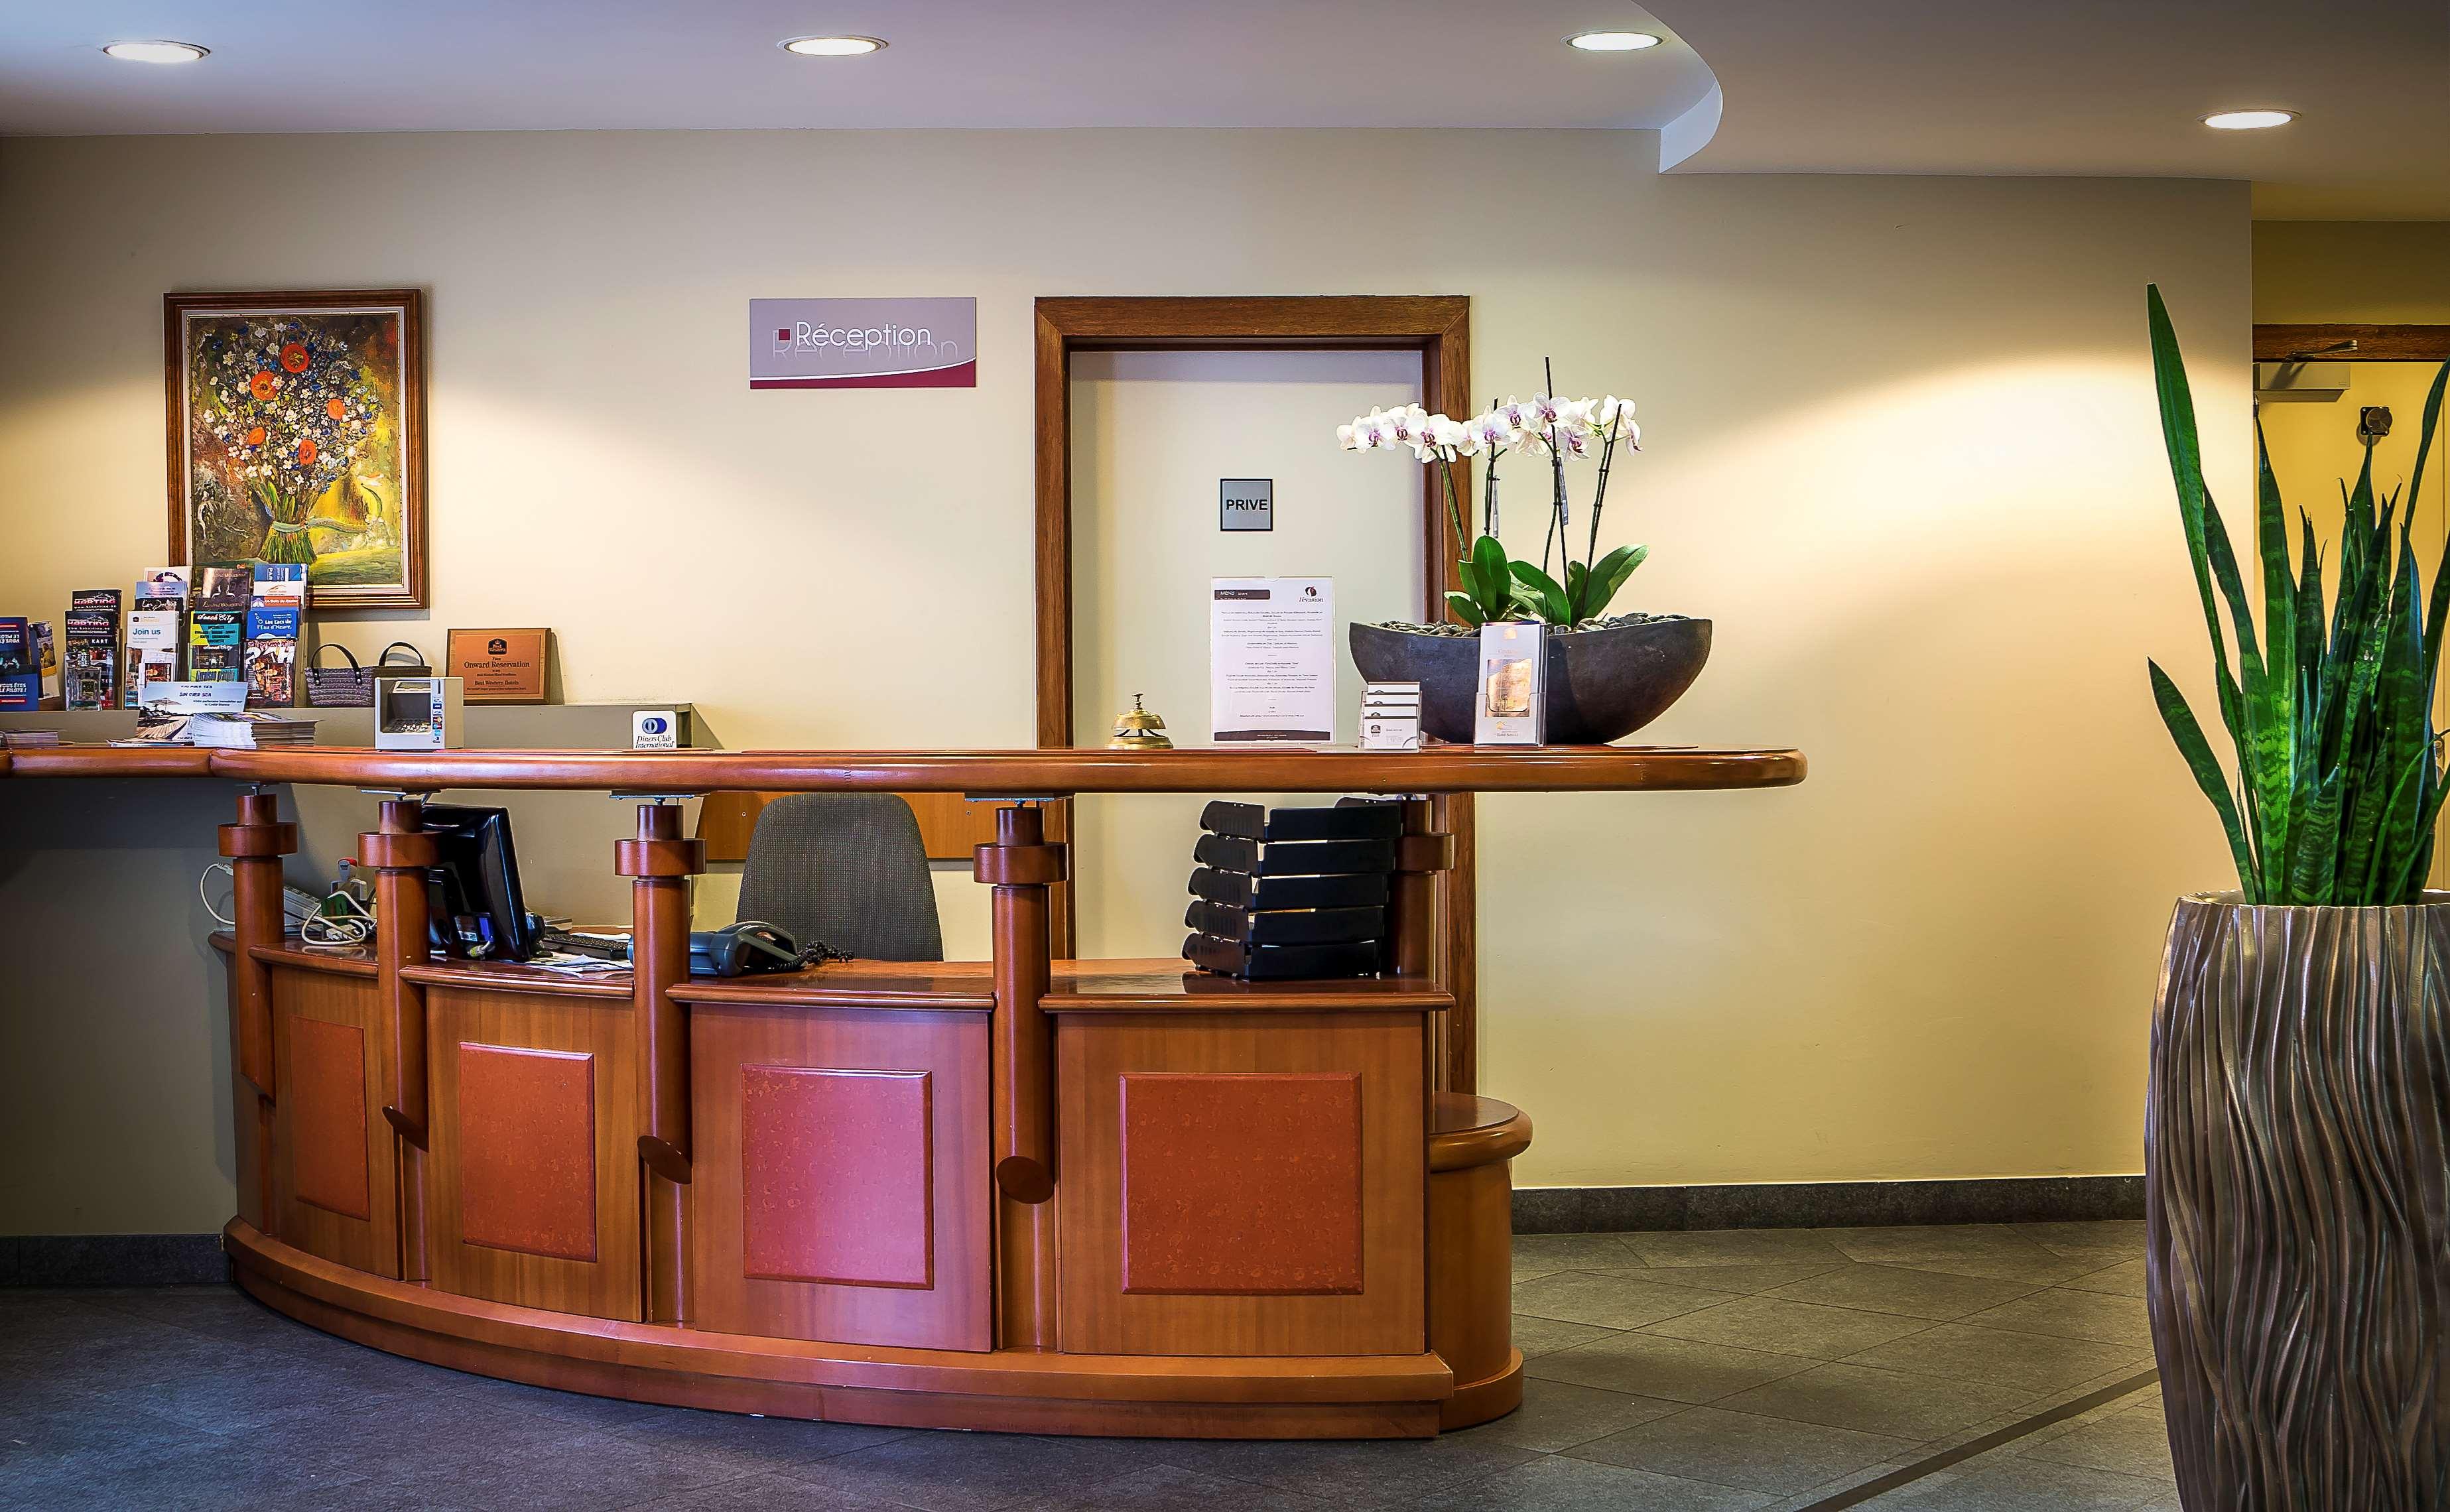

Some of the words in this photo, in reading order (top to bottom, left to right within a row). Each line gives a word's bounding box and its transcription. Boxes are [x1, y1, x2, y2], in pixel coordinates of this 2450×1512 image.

[795, 320, 932, 351] Réception
[1225, 499, 1269, 511] PRIVE
[657, 734, 672, 743] Club
